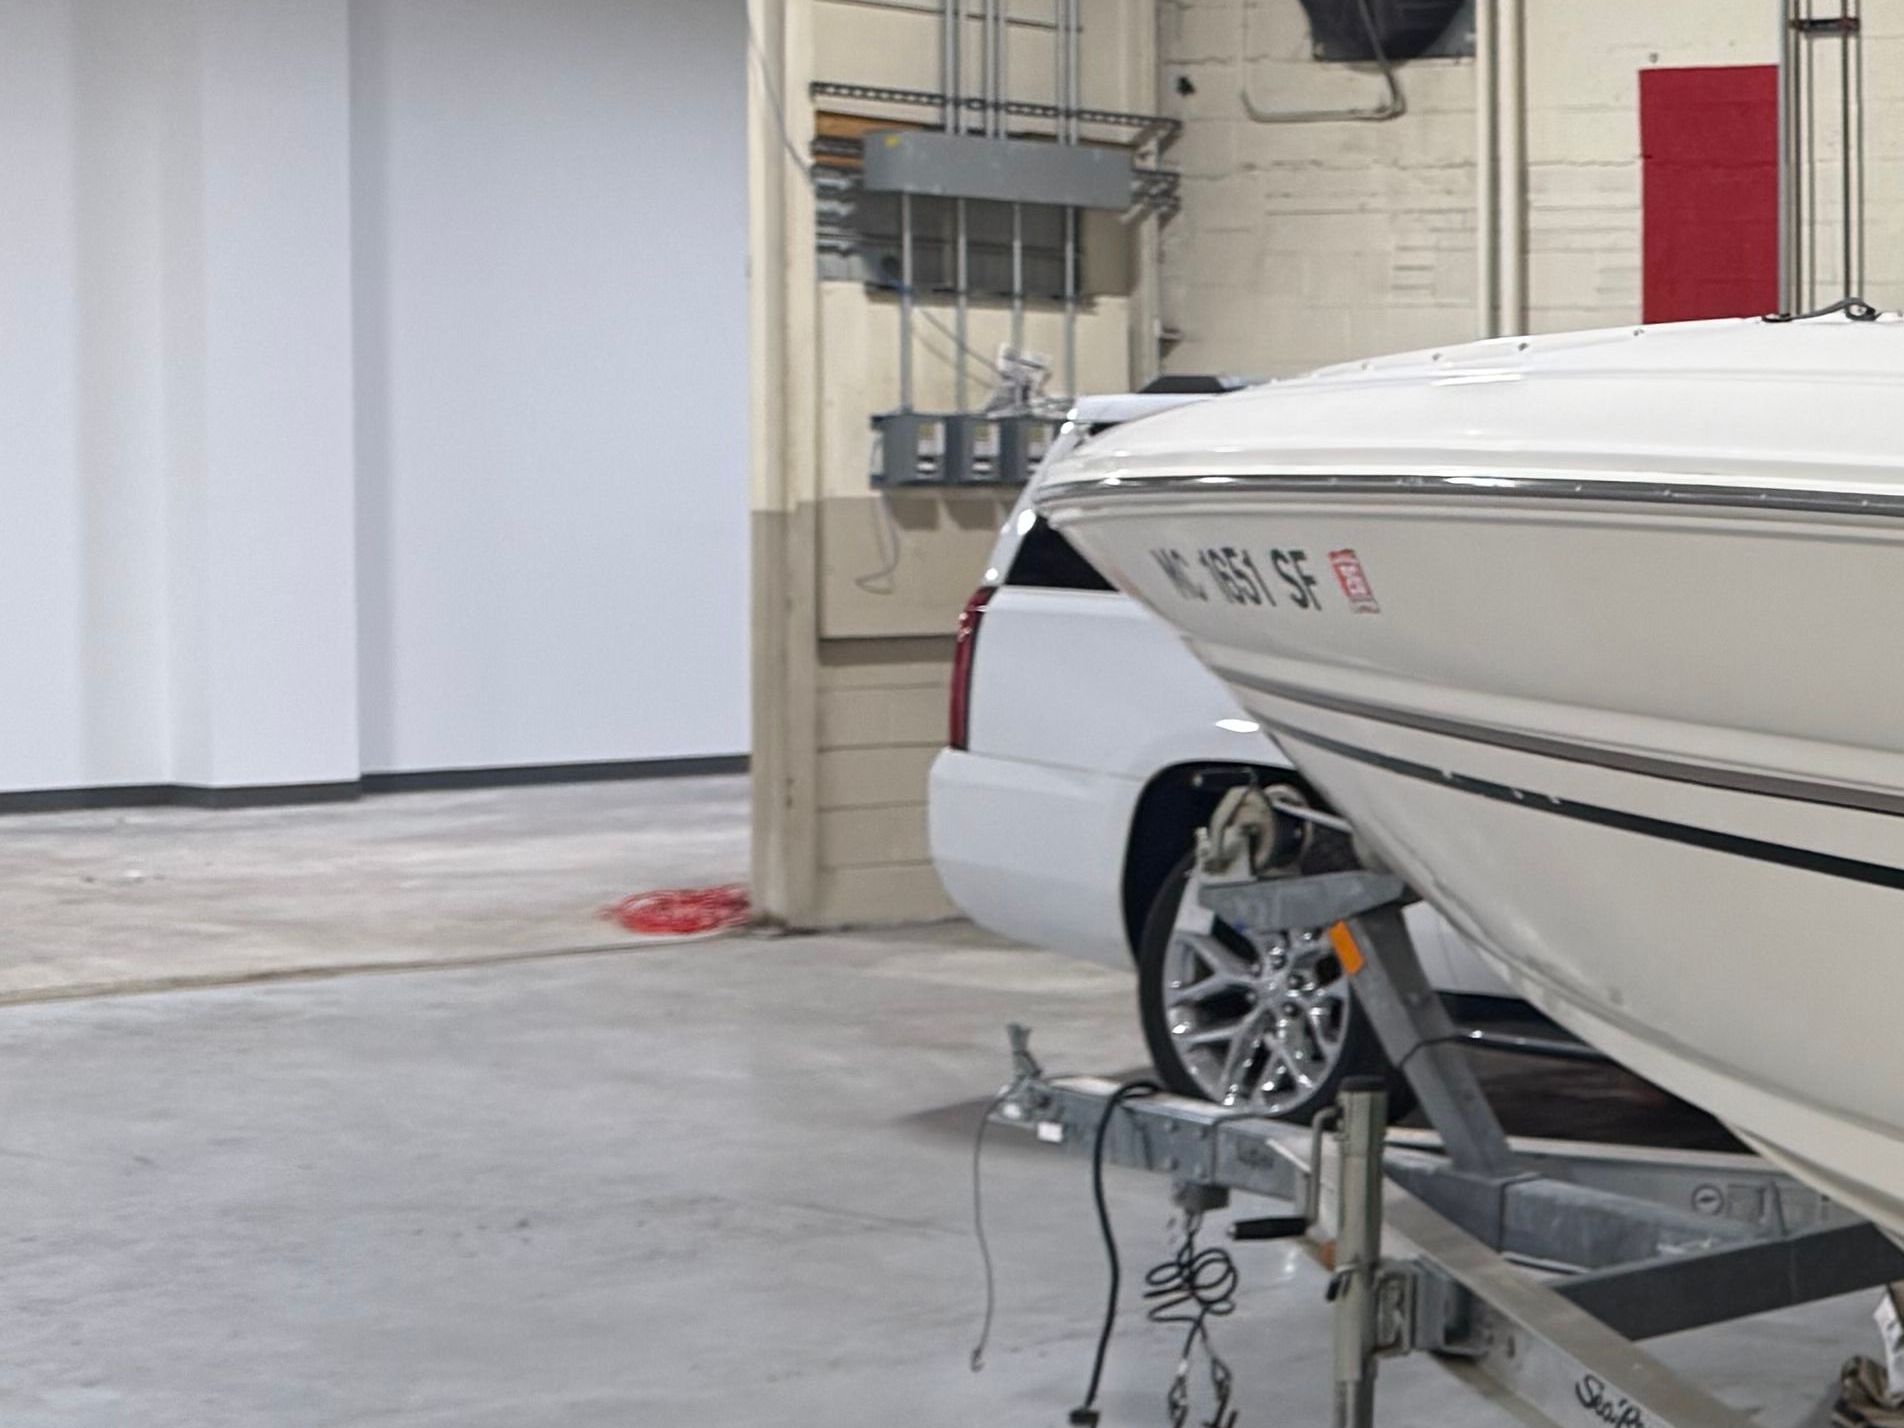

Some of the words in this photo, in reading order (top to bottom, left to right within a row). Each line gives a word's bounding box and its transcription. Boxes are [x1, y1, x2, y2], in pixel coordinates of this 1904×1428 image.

[1149, 548, 1208, 602] MC
[1198, 546, 1277, 608] 1651
[1270, 548, 1322, 611] SF
[1575, 1374, 1617, 1424] Sea
